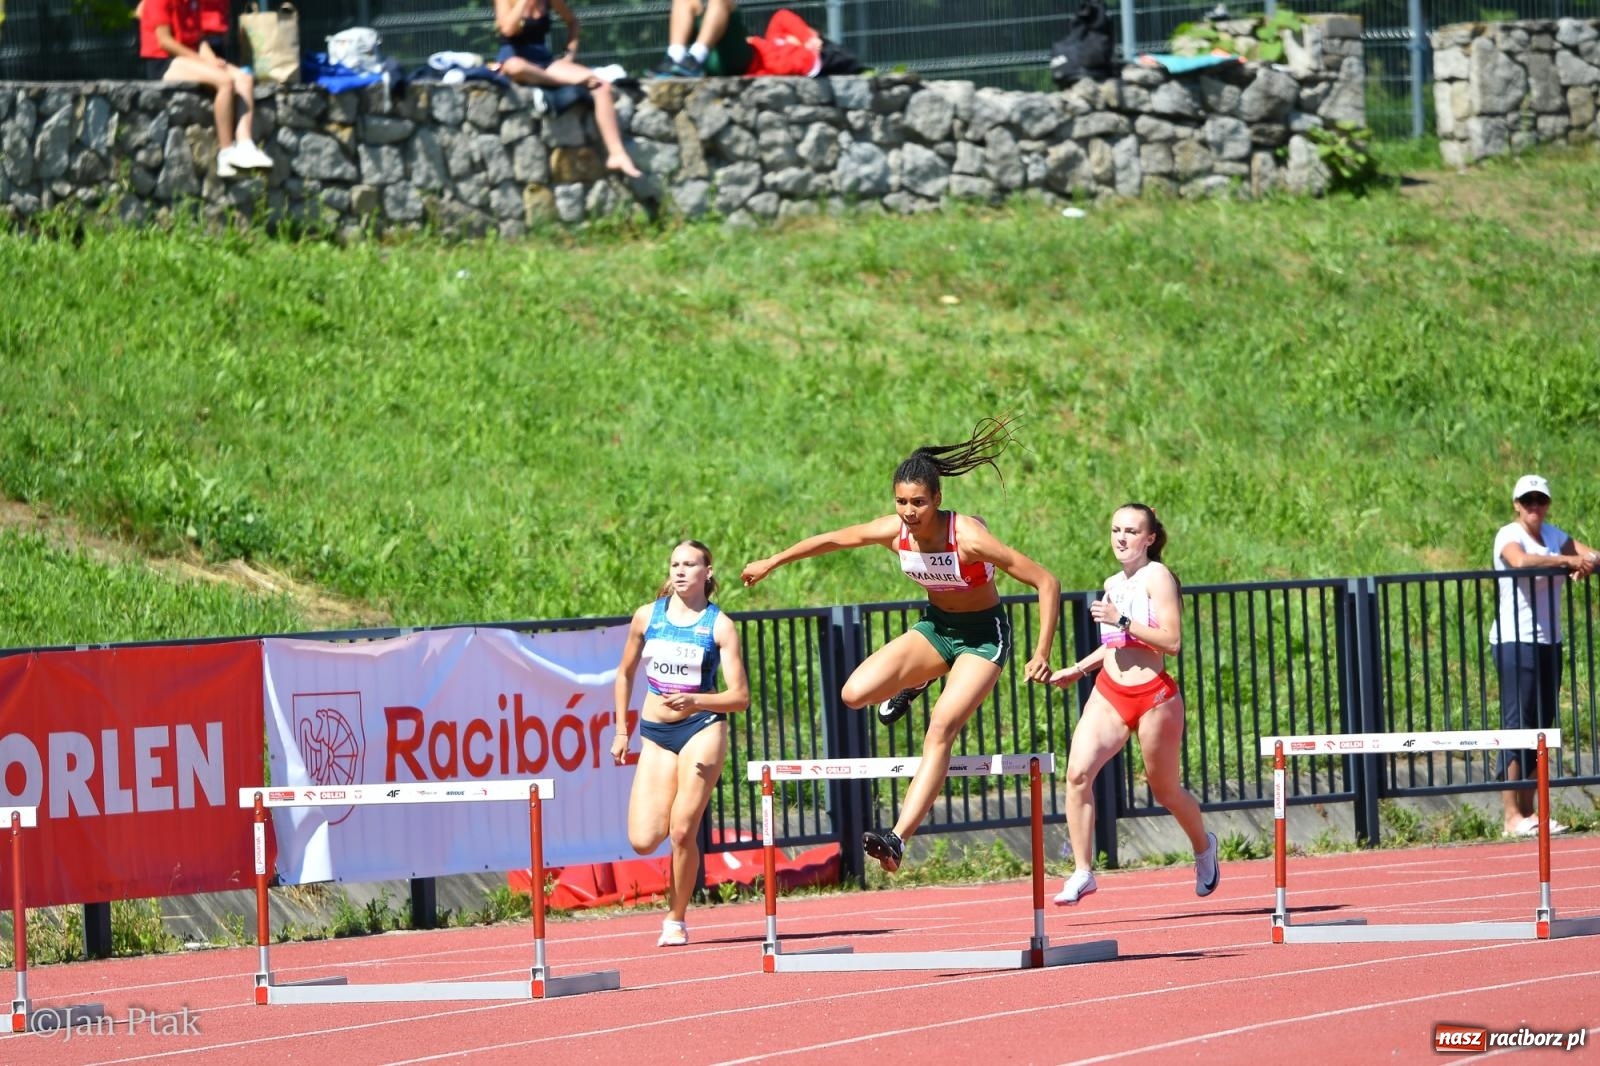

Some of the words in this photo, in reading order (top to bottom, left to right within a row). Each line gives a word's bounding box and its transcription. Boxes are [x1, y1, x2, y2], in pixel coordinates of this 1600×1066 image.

[930, 555, 952, 566] 216
[675, 646, 697, 658] 515
[0, 721, 226, 819] ORLEN
